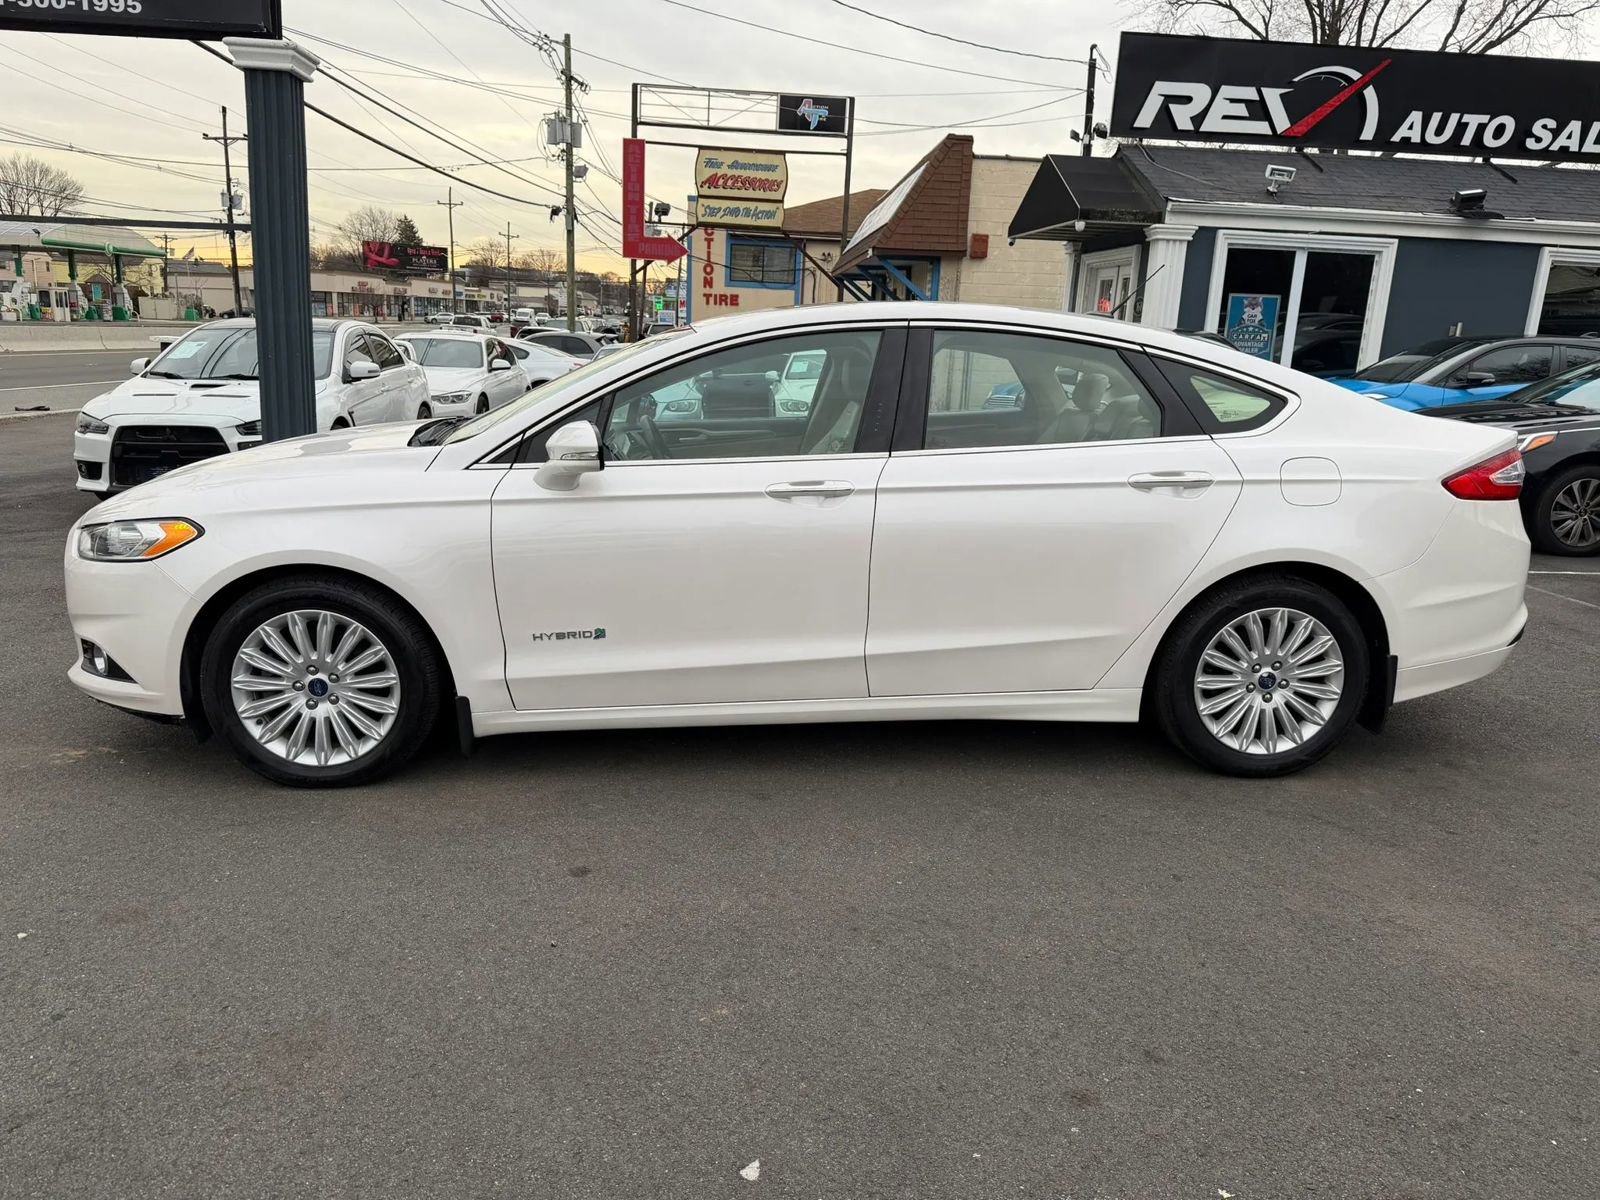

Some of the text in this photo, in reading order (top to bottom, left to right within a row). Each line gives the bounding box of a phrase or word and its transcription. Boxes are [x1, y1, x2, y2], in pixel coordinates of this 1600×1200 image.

[1390, 111, 1516, 148] AUTO
[700, 172, 783, 192] ACCESSORIES
[703, 294, 740, 306] TIRE
[532, 630, 593, 641] HYBRID
